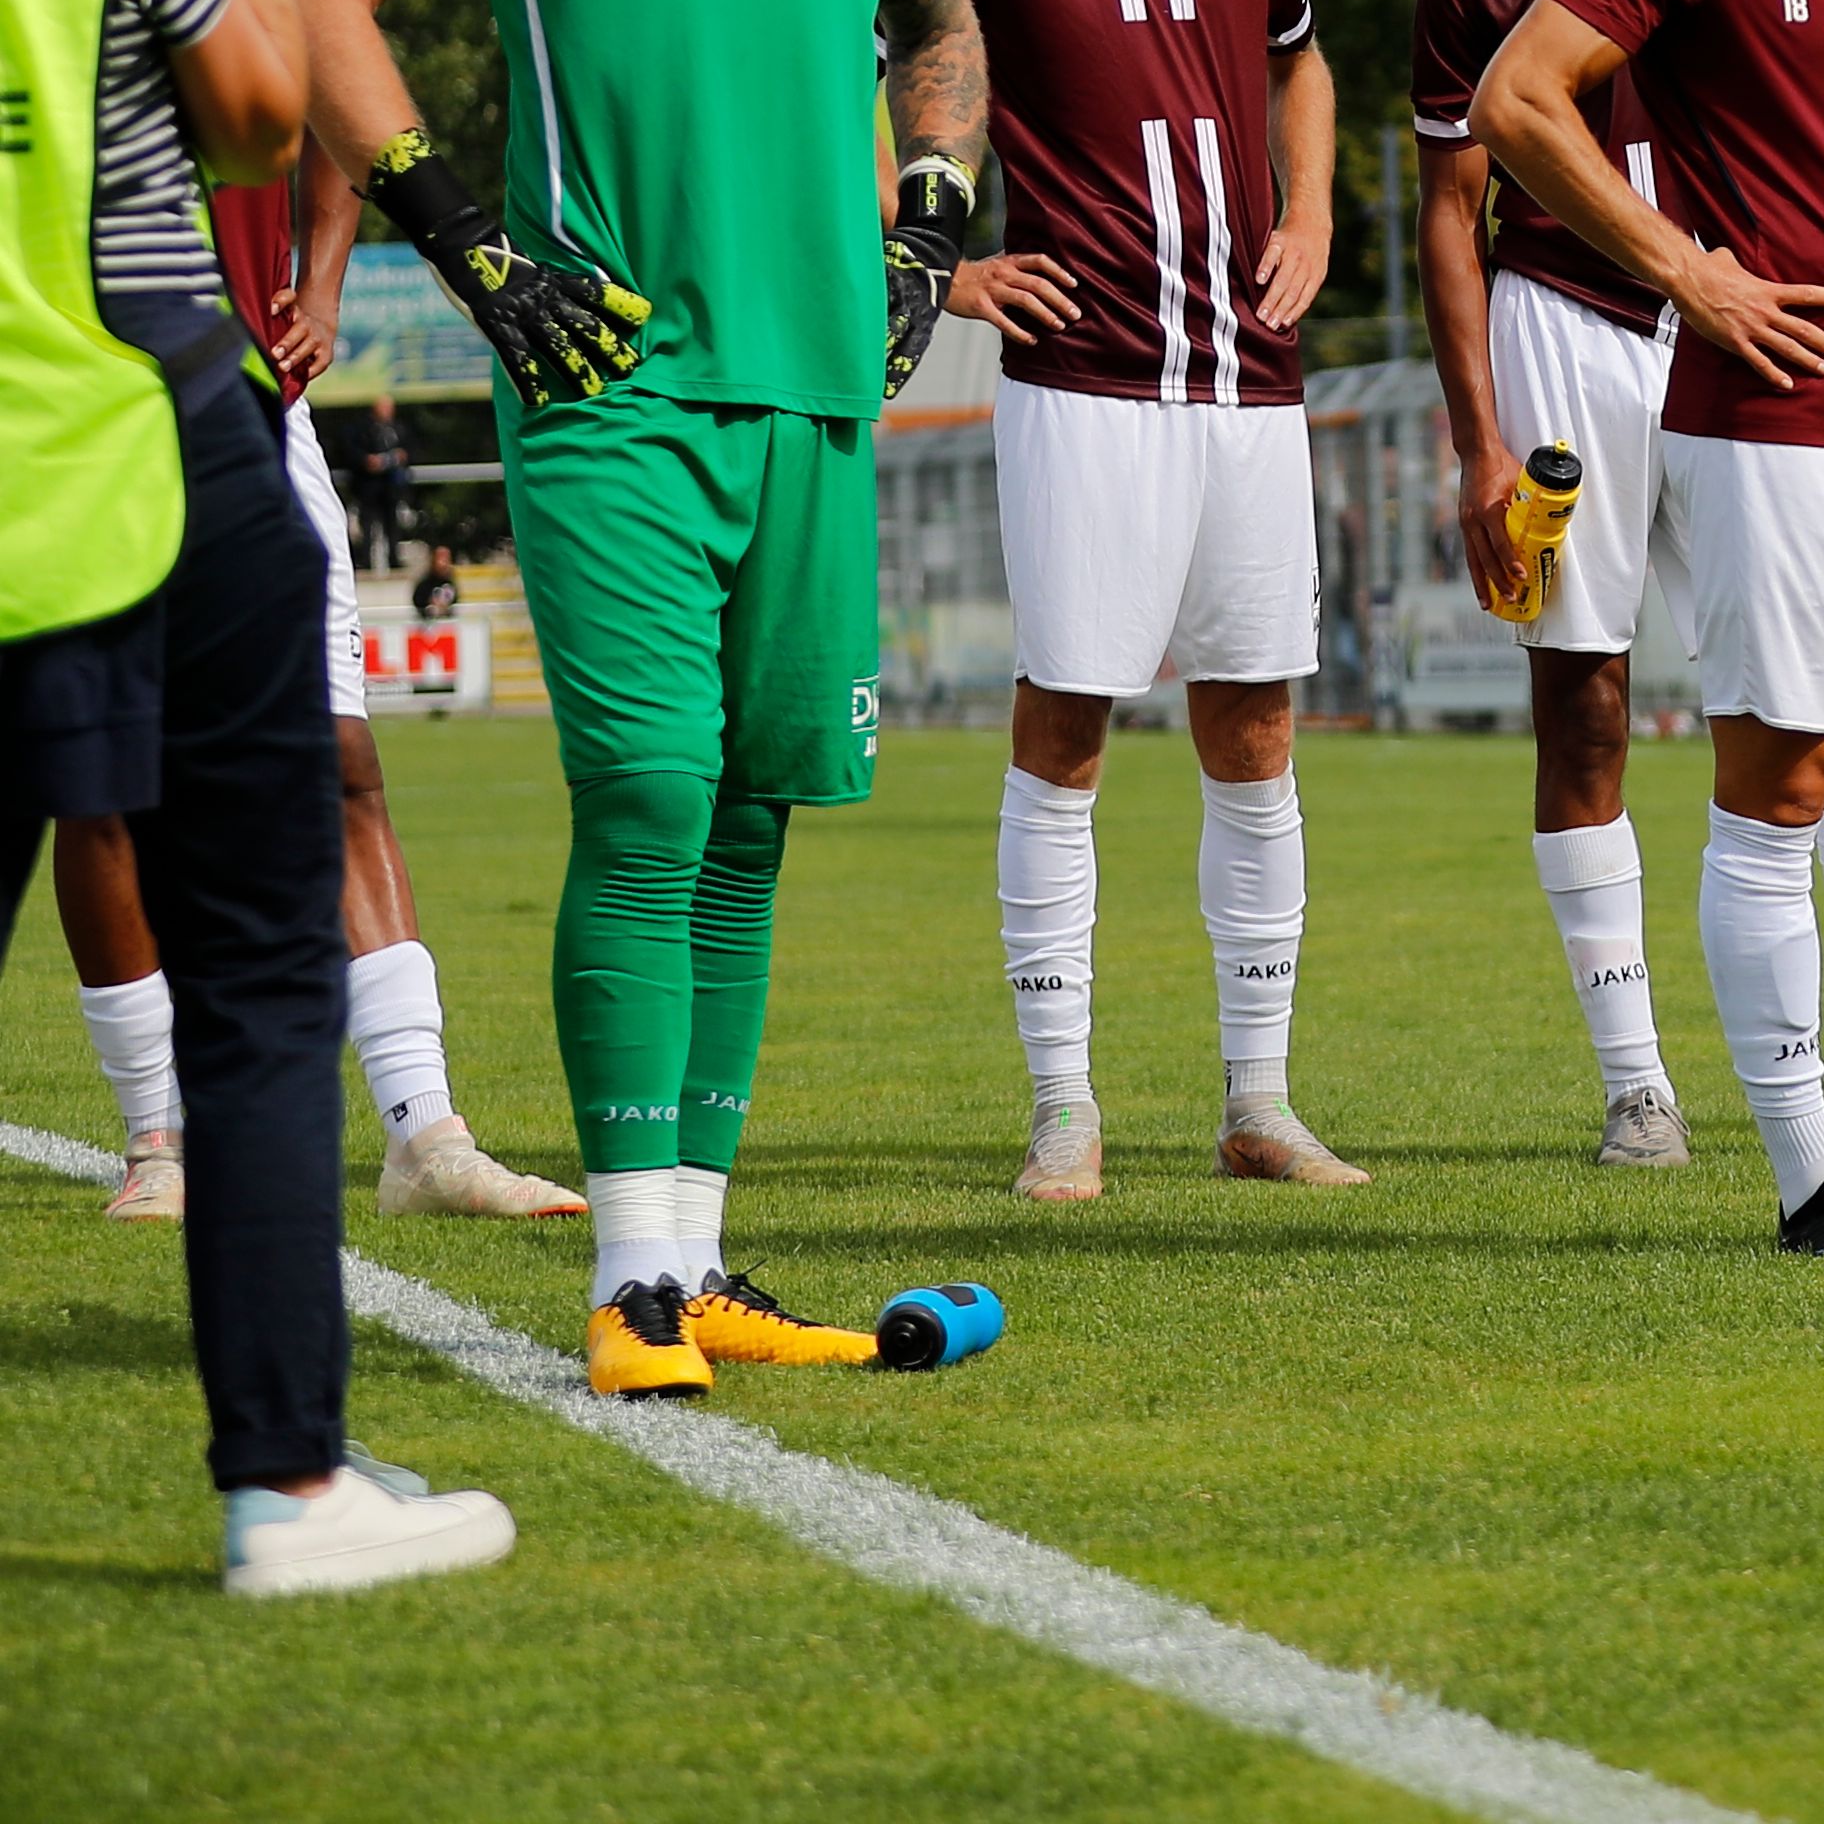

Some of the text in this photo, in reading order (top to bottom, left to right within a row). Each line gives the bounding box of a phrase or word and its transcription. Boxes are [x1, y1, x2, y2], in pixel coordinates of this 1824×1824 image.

[1234, 961, 1291, 980] JAKO
[1590, 963, 1646, 988] JAKO
[603, 1105, 679, 1122] JAKO
